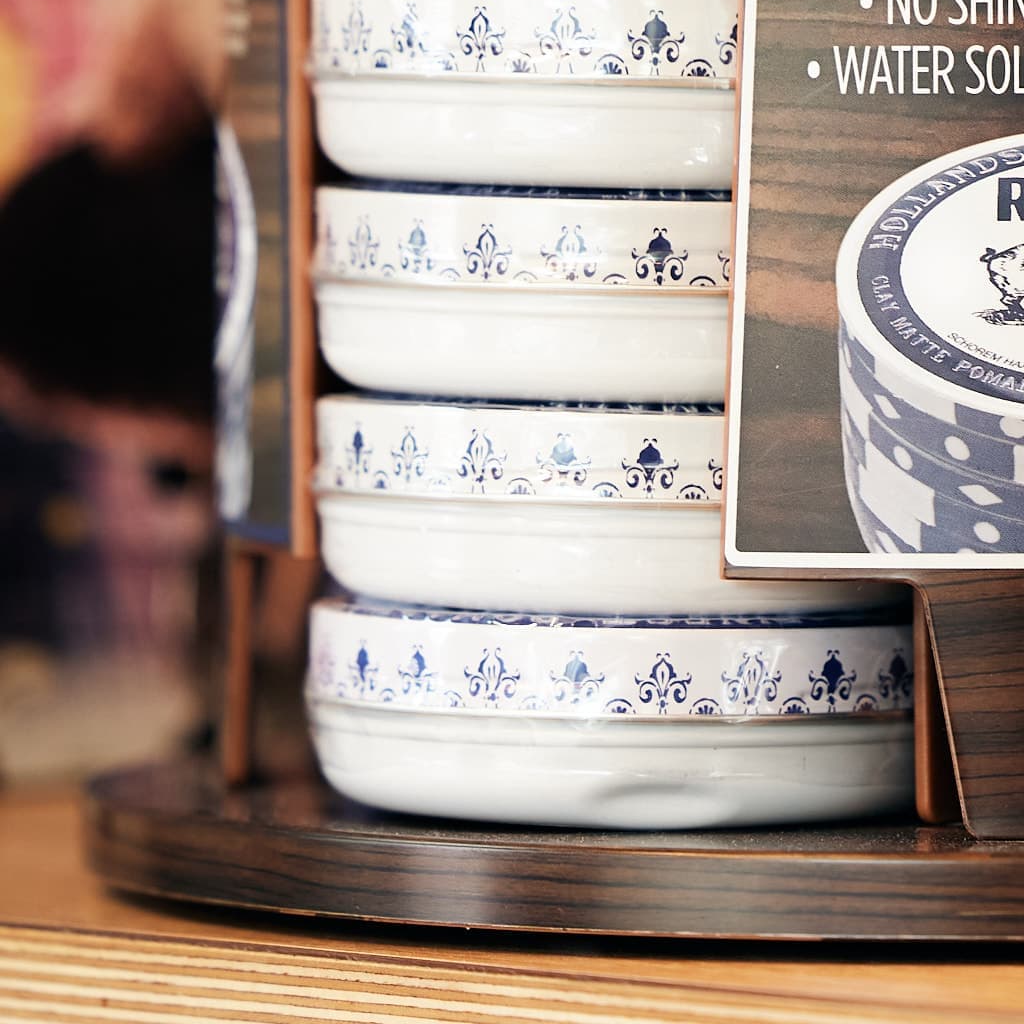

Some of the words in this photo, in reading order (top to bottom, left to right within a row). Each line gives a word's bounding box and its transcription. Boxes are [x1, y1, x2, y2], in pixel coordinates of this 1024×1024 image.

[832, 45, 955, 95] WATER
[871, 274, 901, 313] CLAY
[888, 316, 951, 364] MATTE
[947, 331, 1003, 363] SCHOREM
